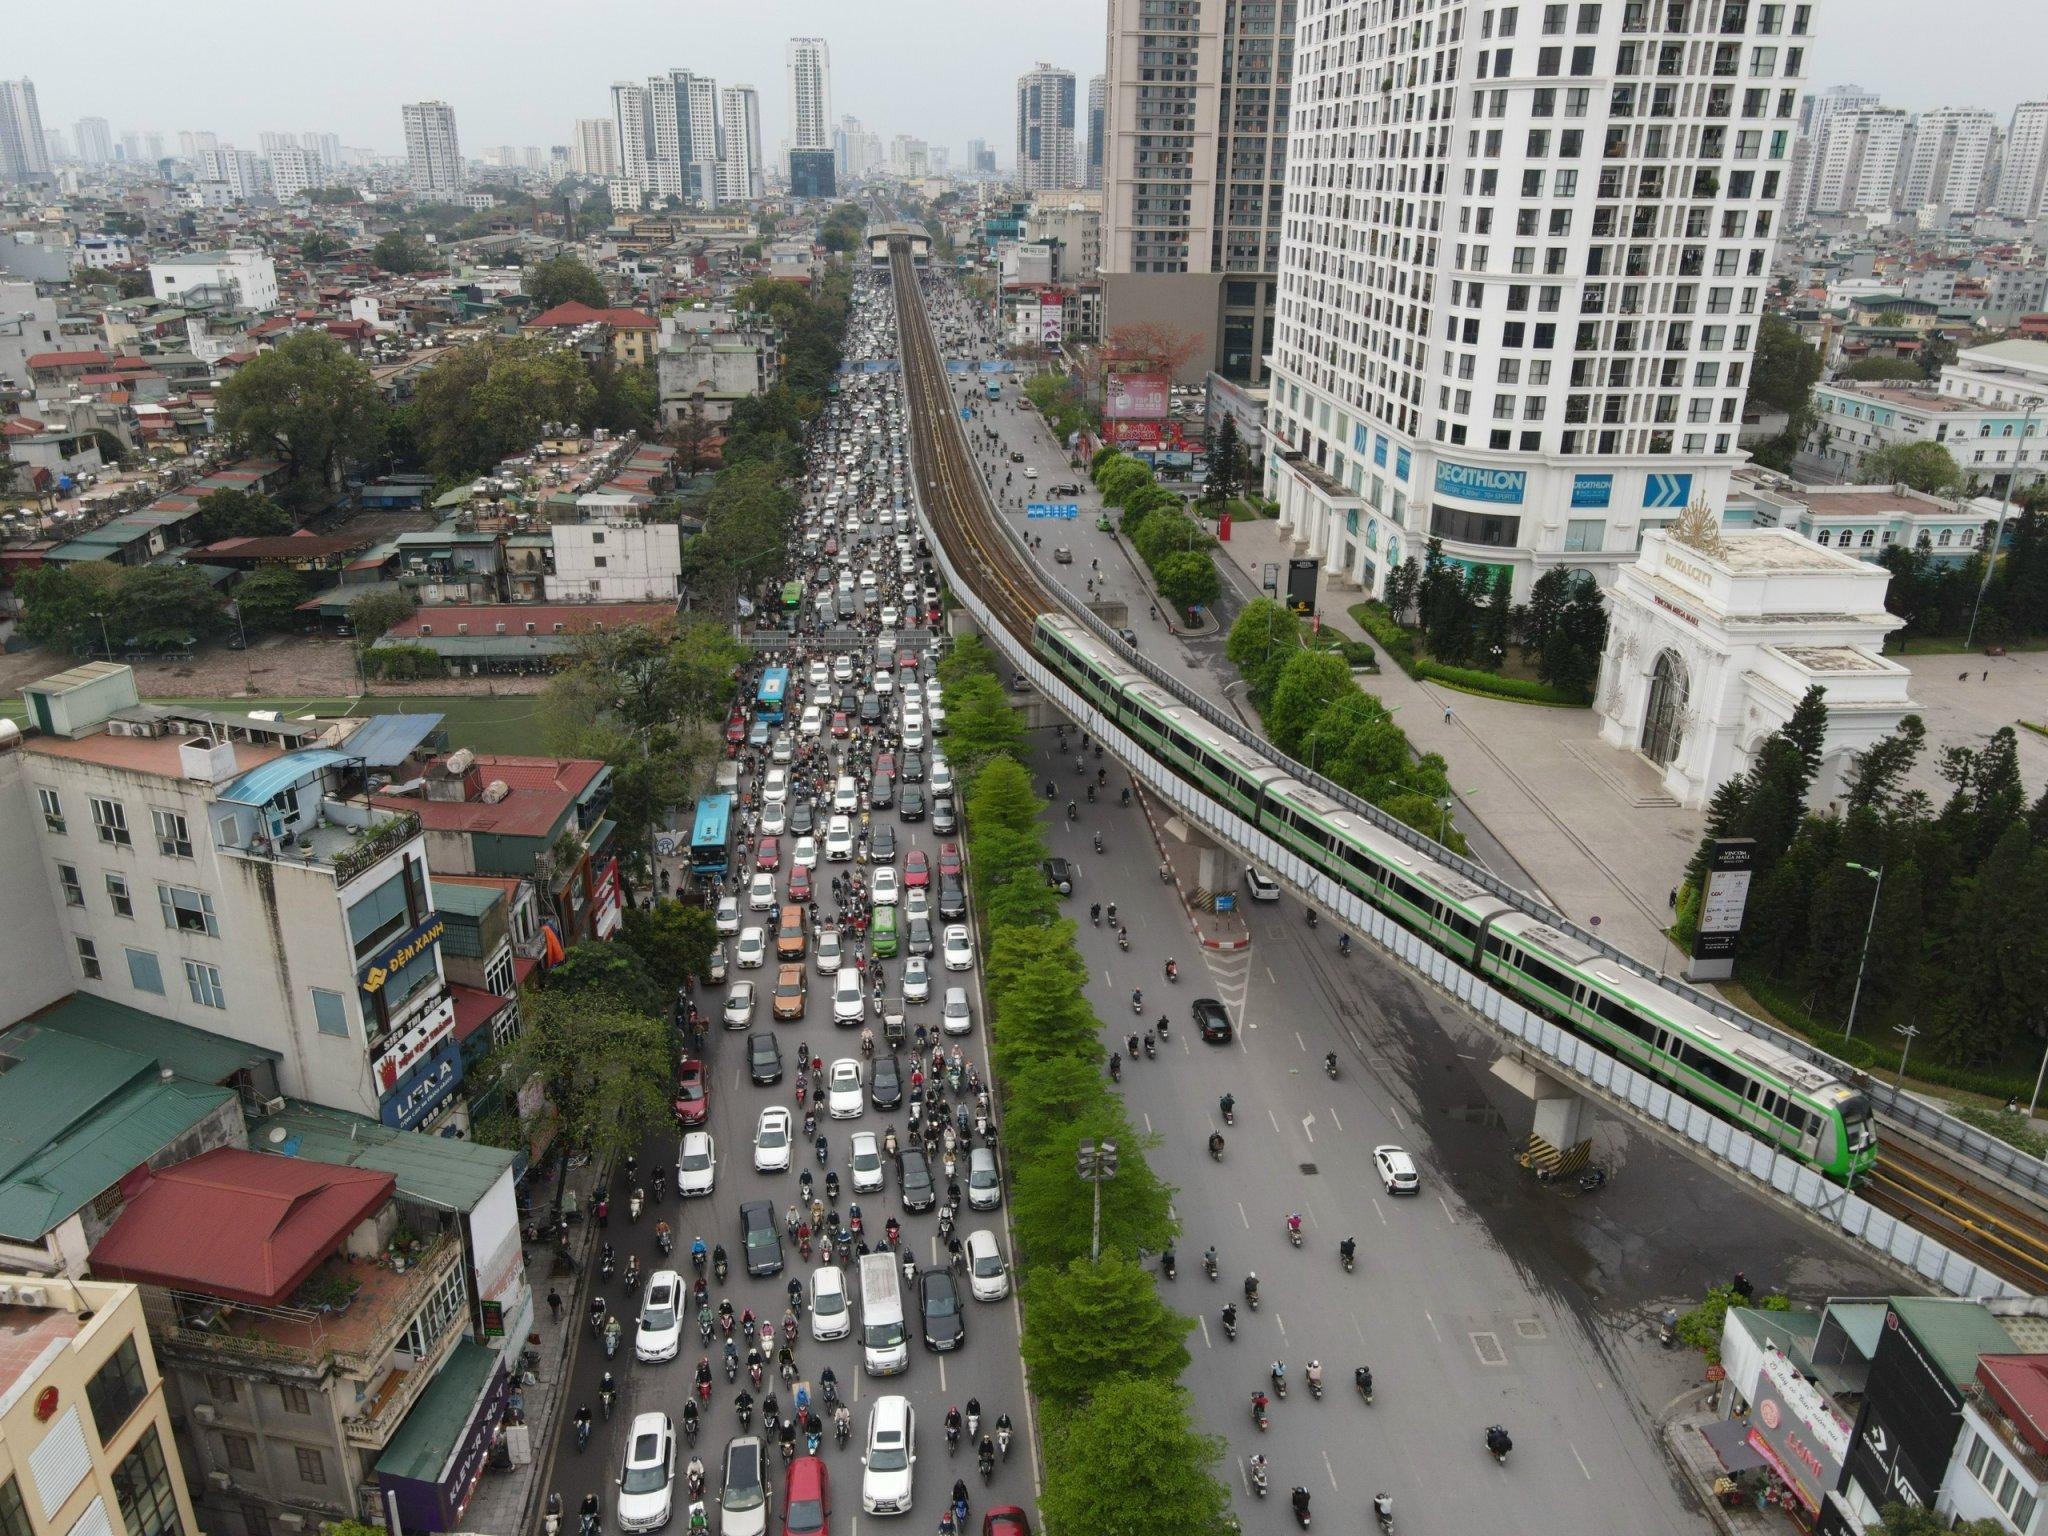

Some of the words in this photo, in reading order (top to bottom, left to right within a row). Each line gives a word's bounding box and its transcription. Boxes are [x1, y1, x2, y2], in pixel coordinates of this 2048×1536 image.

[1437, 461, 1524, 490] DECATHLON
[1574, 481, 1611, 489] DECATHLON
[1654, 595, 1672, 611] VINCOM
[1672, 605, 1686, 619] MEGA
[1685, 613, 1699, 627] MALL
[389, 945, 415, 972] ĐỆM
[415, 922, 444, 952] XANH
[1862, 1432, 1890, 1475] CONVERSE
[1894, 1465, 1924, 1510] VAN
